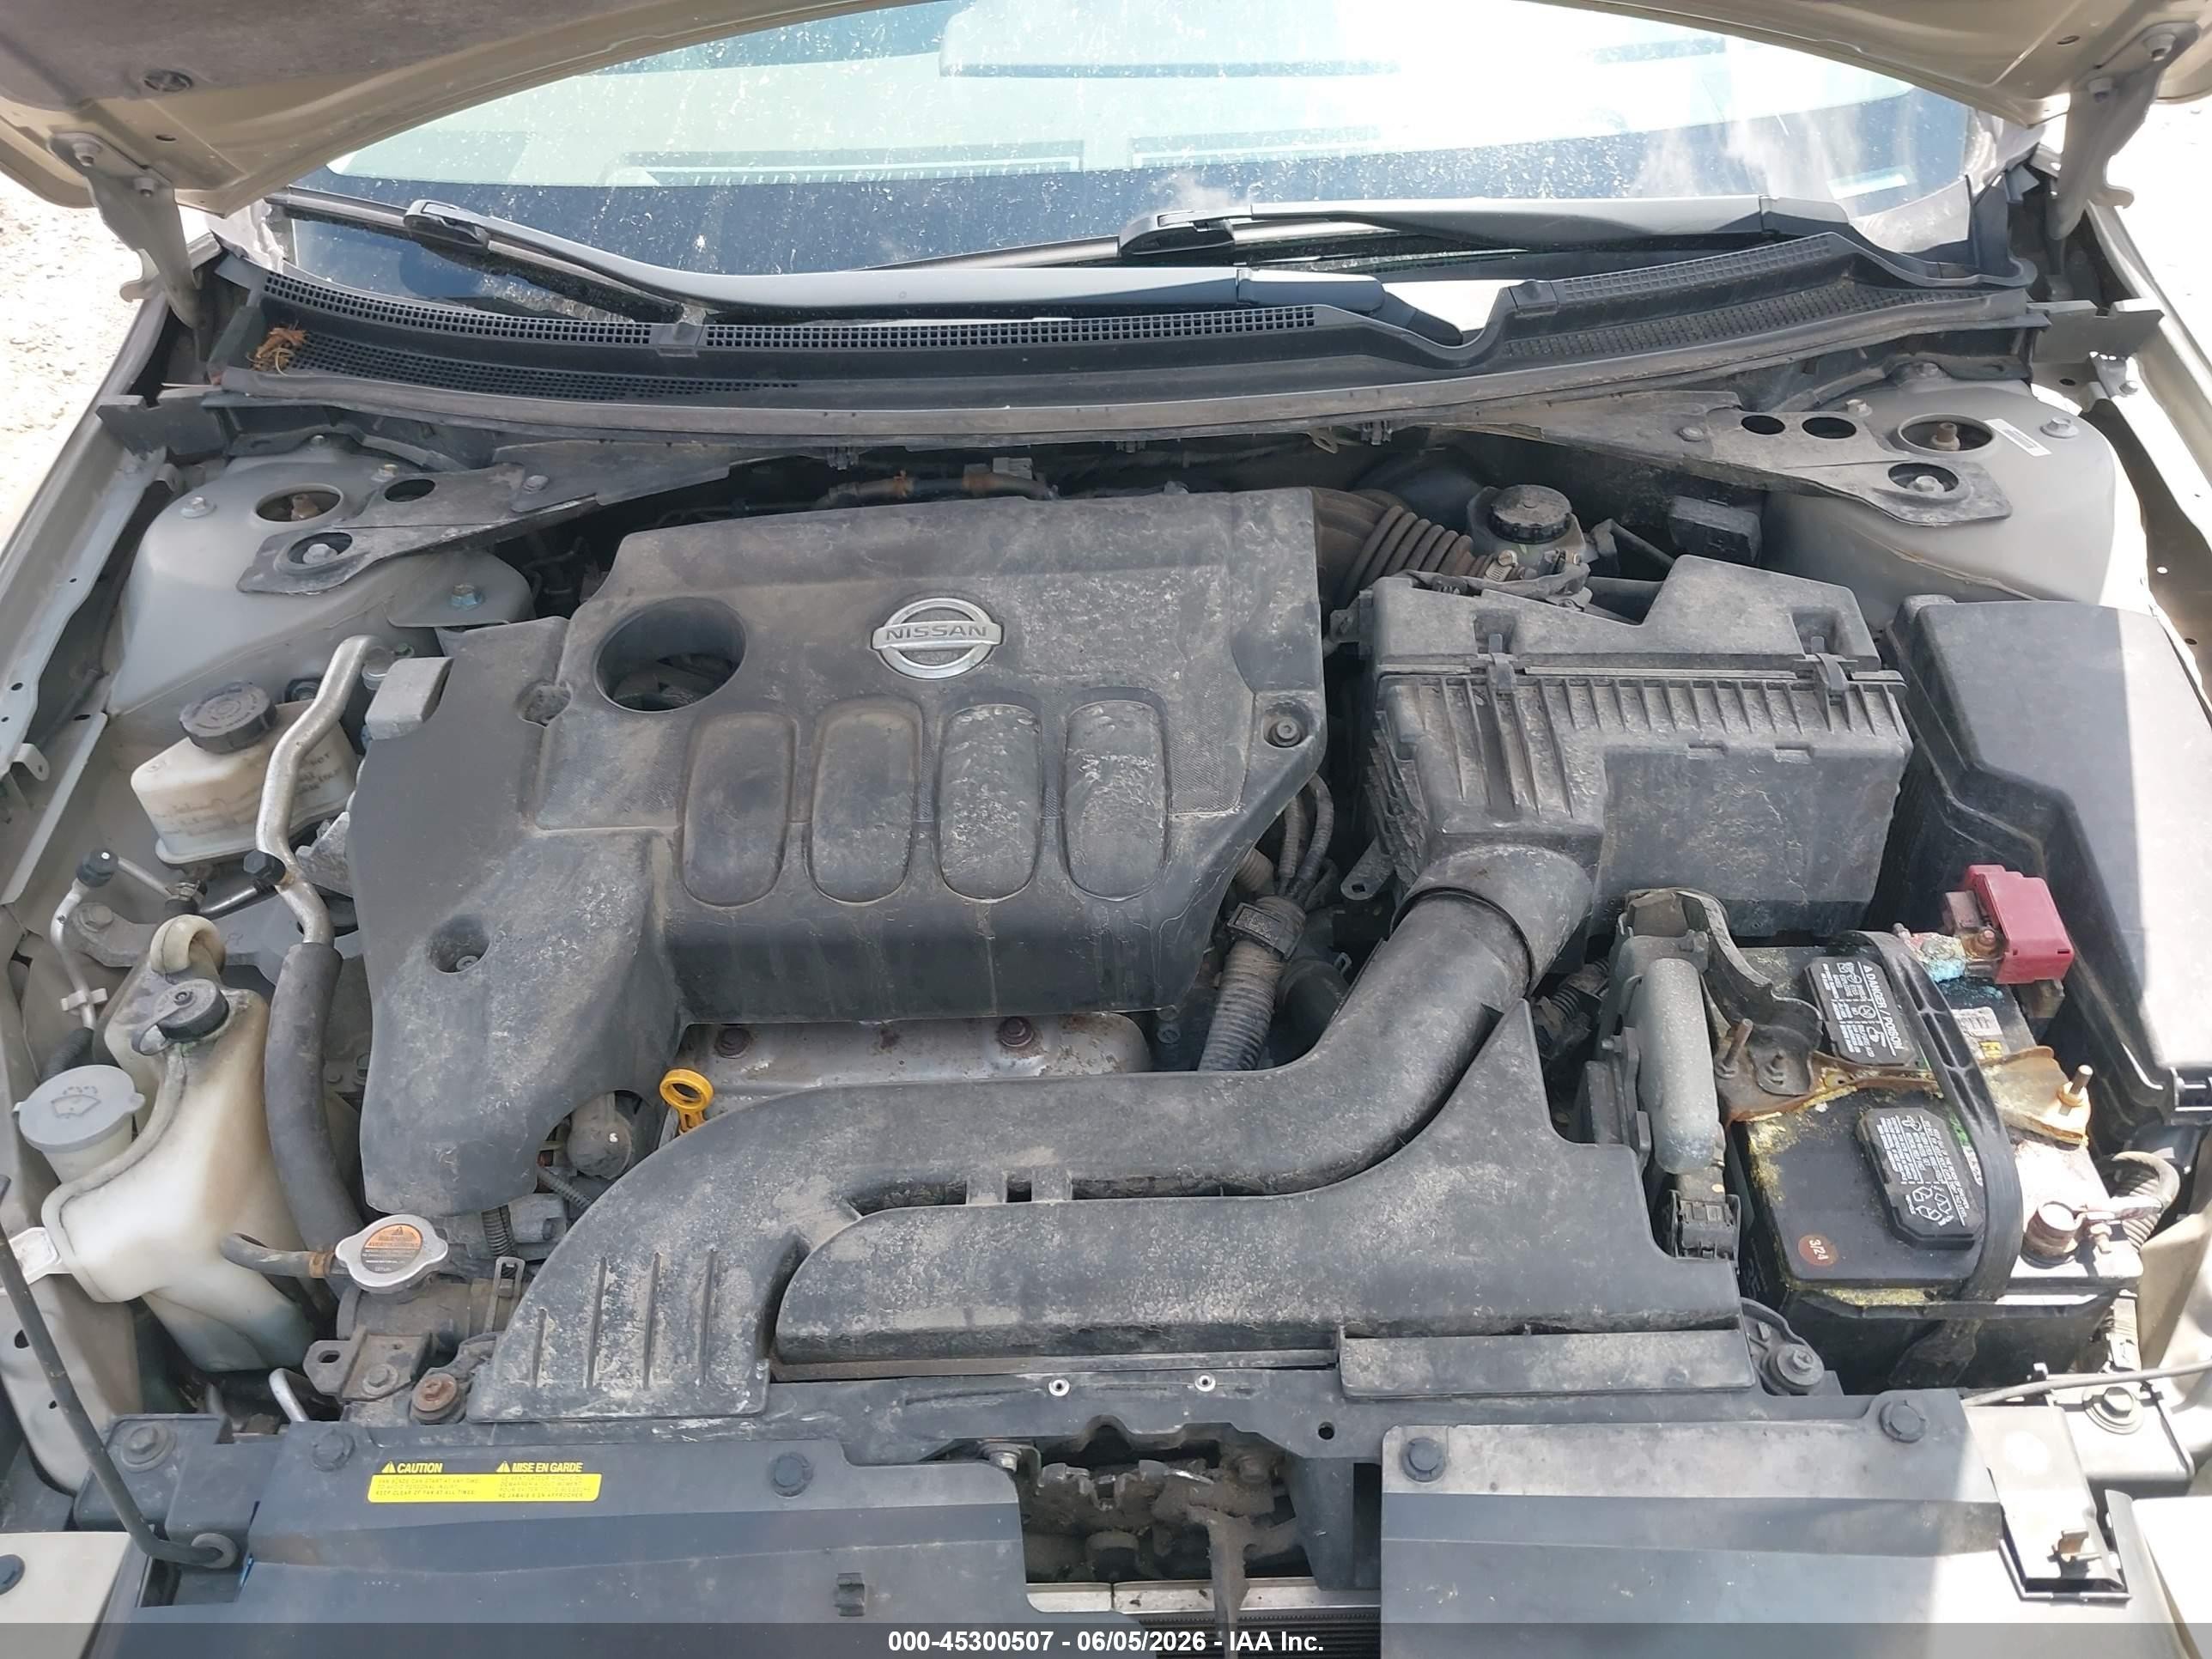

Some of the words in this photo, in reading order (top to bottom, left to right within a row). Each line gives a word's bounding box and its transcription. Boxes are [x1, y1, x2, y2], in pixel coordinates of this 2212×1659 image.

[886, 624, 987, 641] NISSAN
[1865, 973, 1888, 1008] DANGER
[1881, 1016, 1904, 1049] POISON
[1808, 1239, 1829, 1261] 3/24
[397, 1462, 443, 1474] CAUTION
[511, 1462, 535, 1473] MISE
[535, 1462, 550, 1473] EN
[550, 1462, 584, 1473] GARDE
